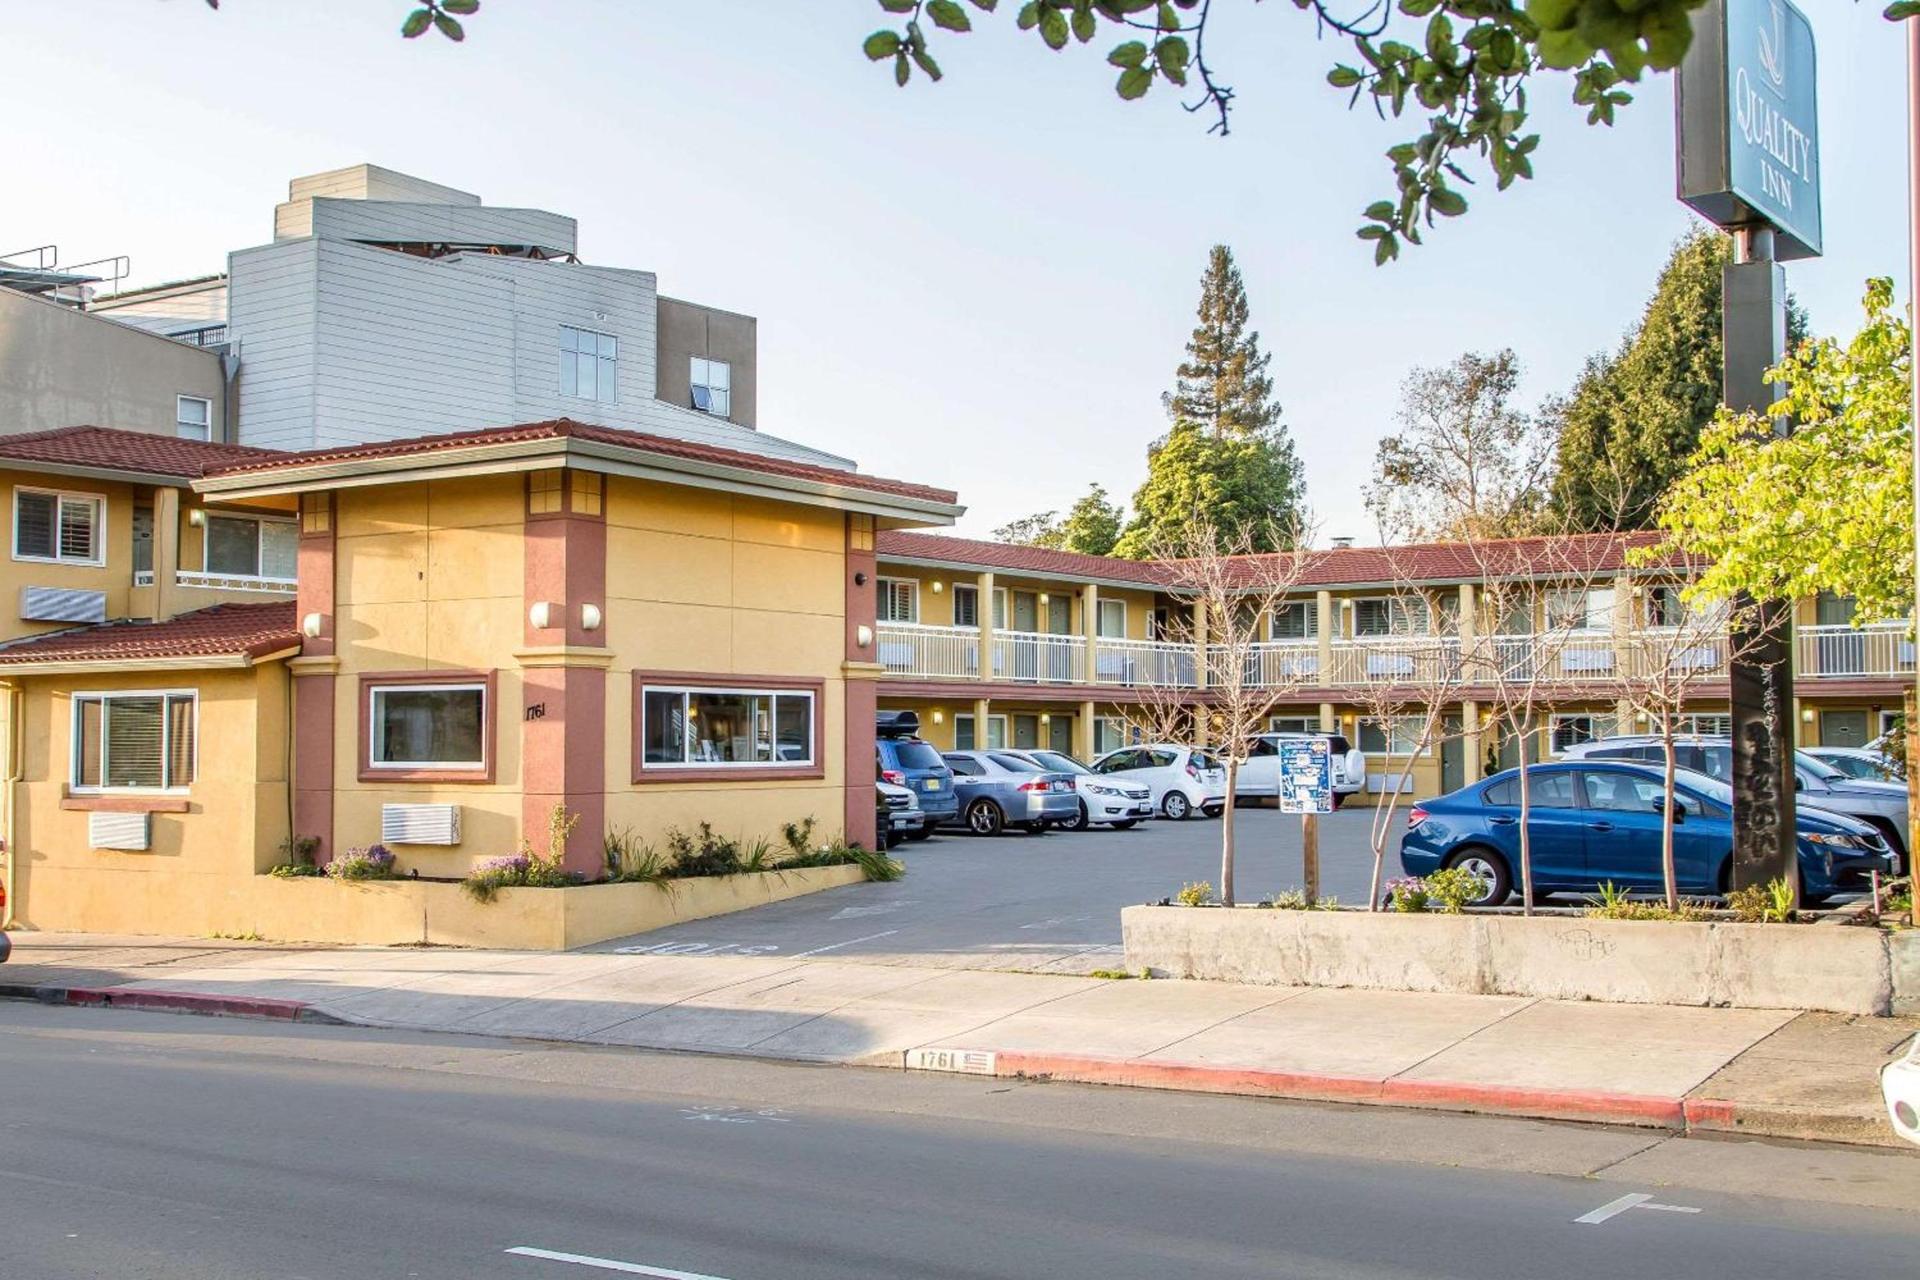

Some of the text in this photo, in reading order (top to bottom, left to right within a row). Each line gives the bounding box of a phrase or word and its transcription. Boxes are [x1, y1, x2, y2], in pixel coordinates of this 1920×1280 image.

[1736, 67, 1810, 183] QUALITY
[1761, 159, 1793, 211] INN
[526, 702, 545, 721] 1761
[920, 1051, 956, 1069] 1761
